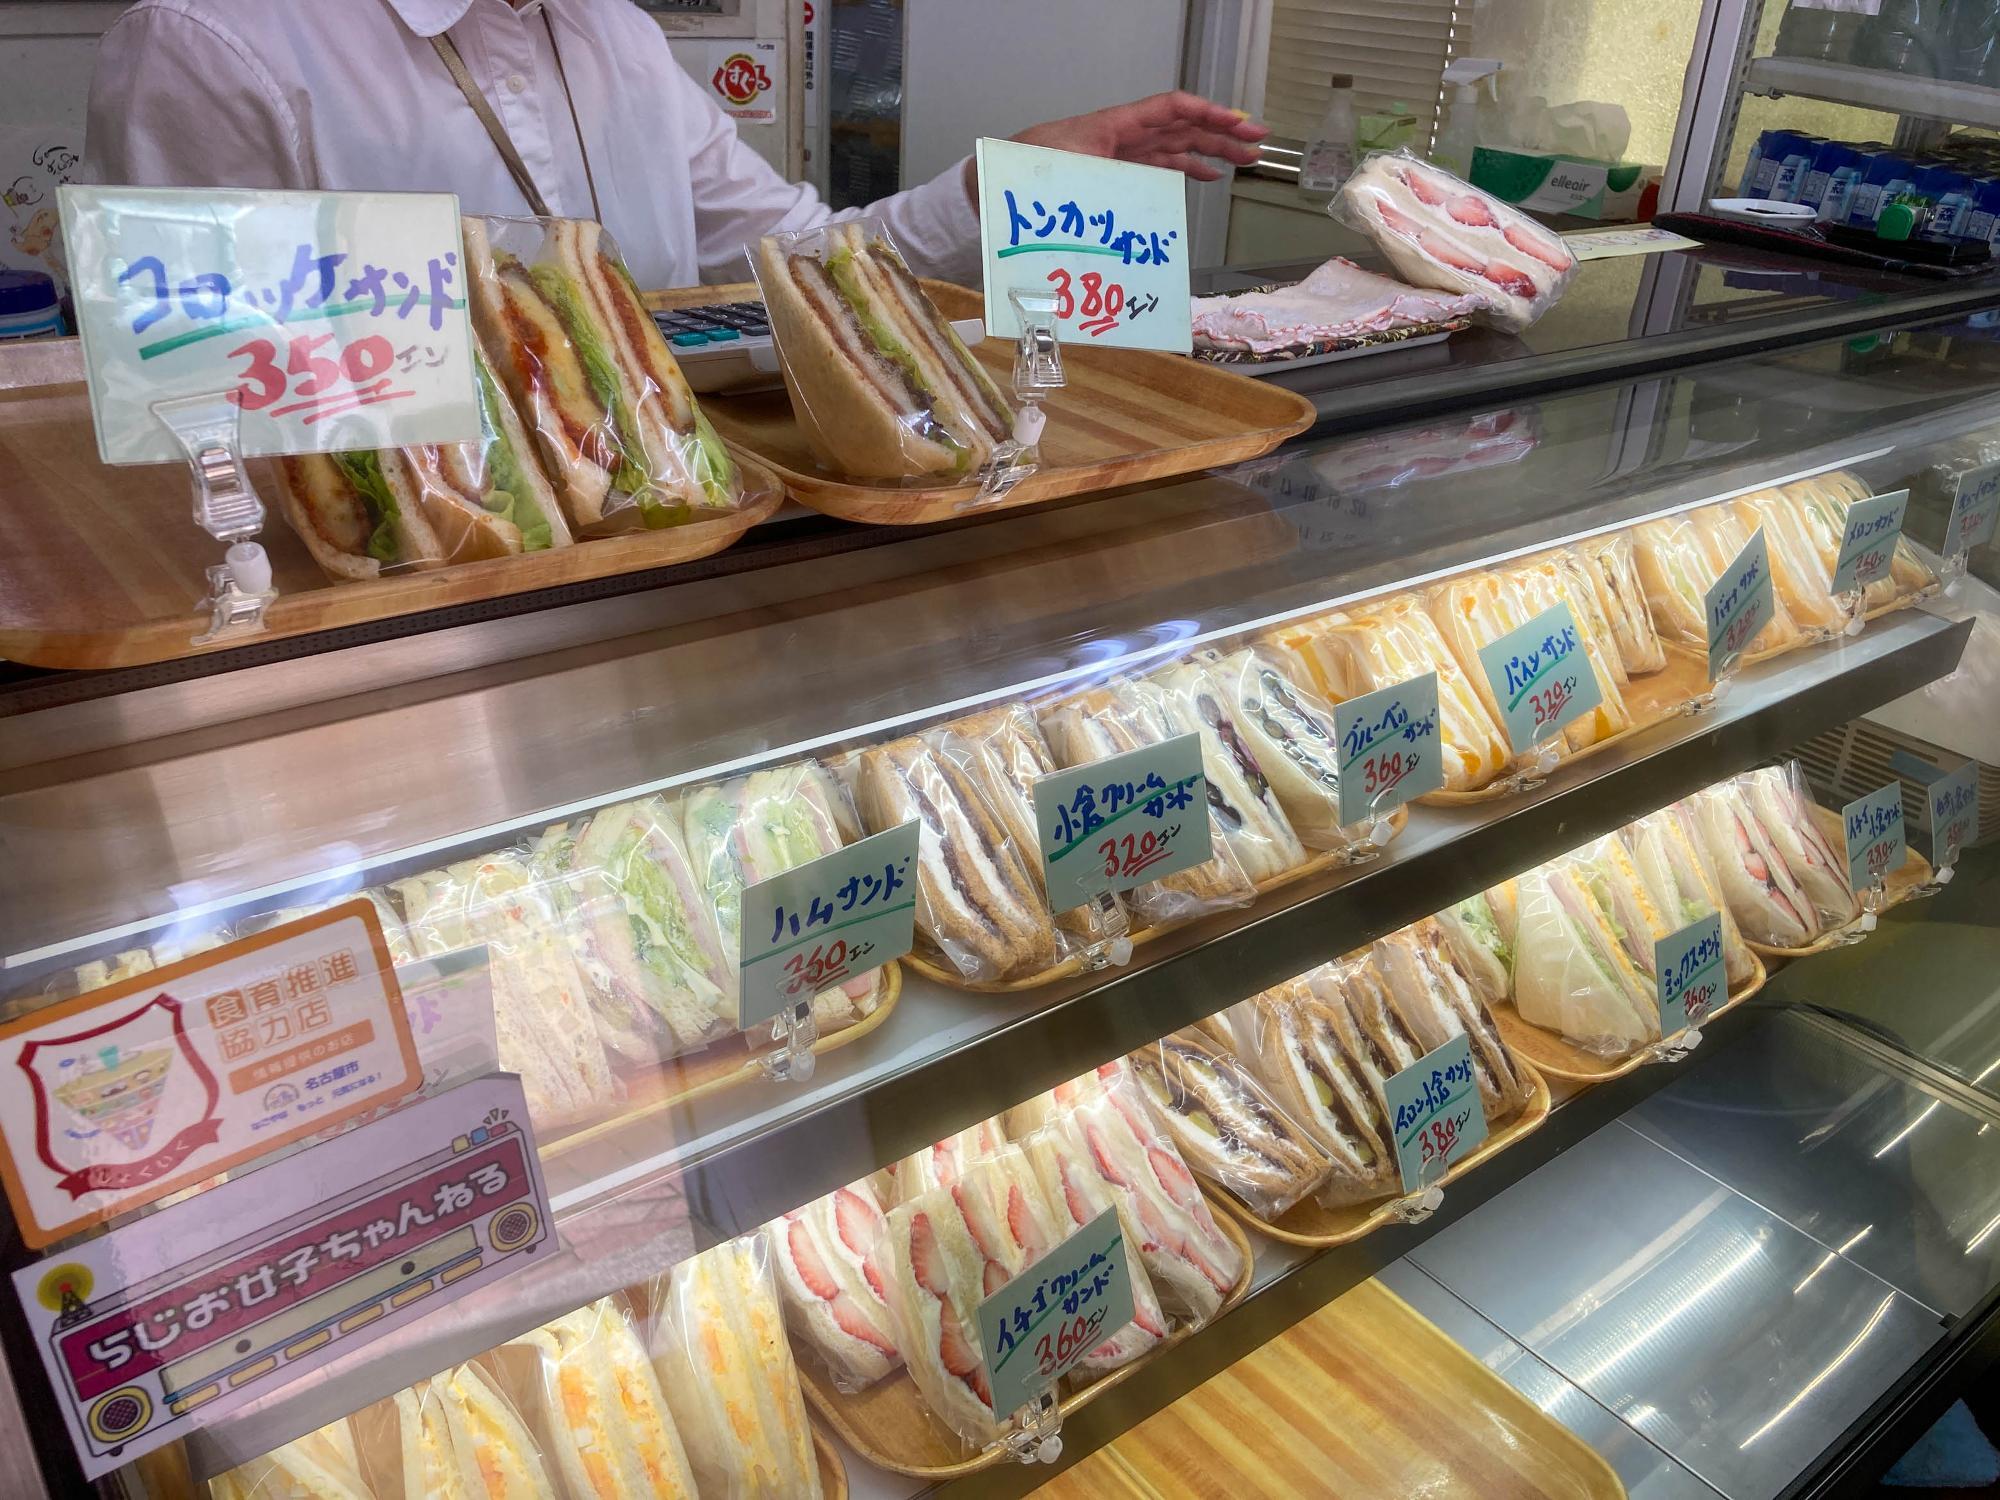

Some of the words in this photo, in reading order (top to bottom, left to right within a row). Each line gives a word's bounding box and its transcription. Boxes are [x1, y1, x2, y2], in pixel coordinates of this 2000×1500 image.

[1551, 175, 1591, 191] elleair
[206, 950, 357, 1029] 食育推進
[220, 998, 329, 1060] 協力店
[305, 1061, 359, 1089] 名古屋市
[90, 1163, 508, 1368] らじお女子ちゃんねる
